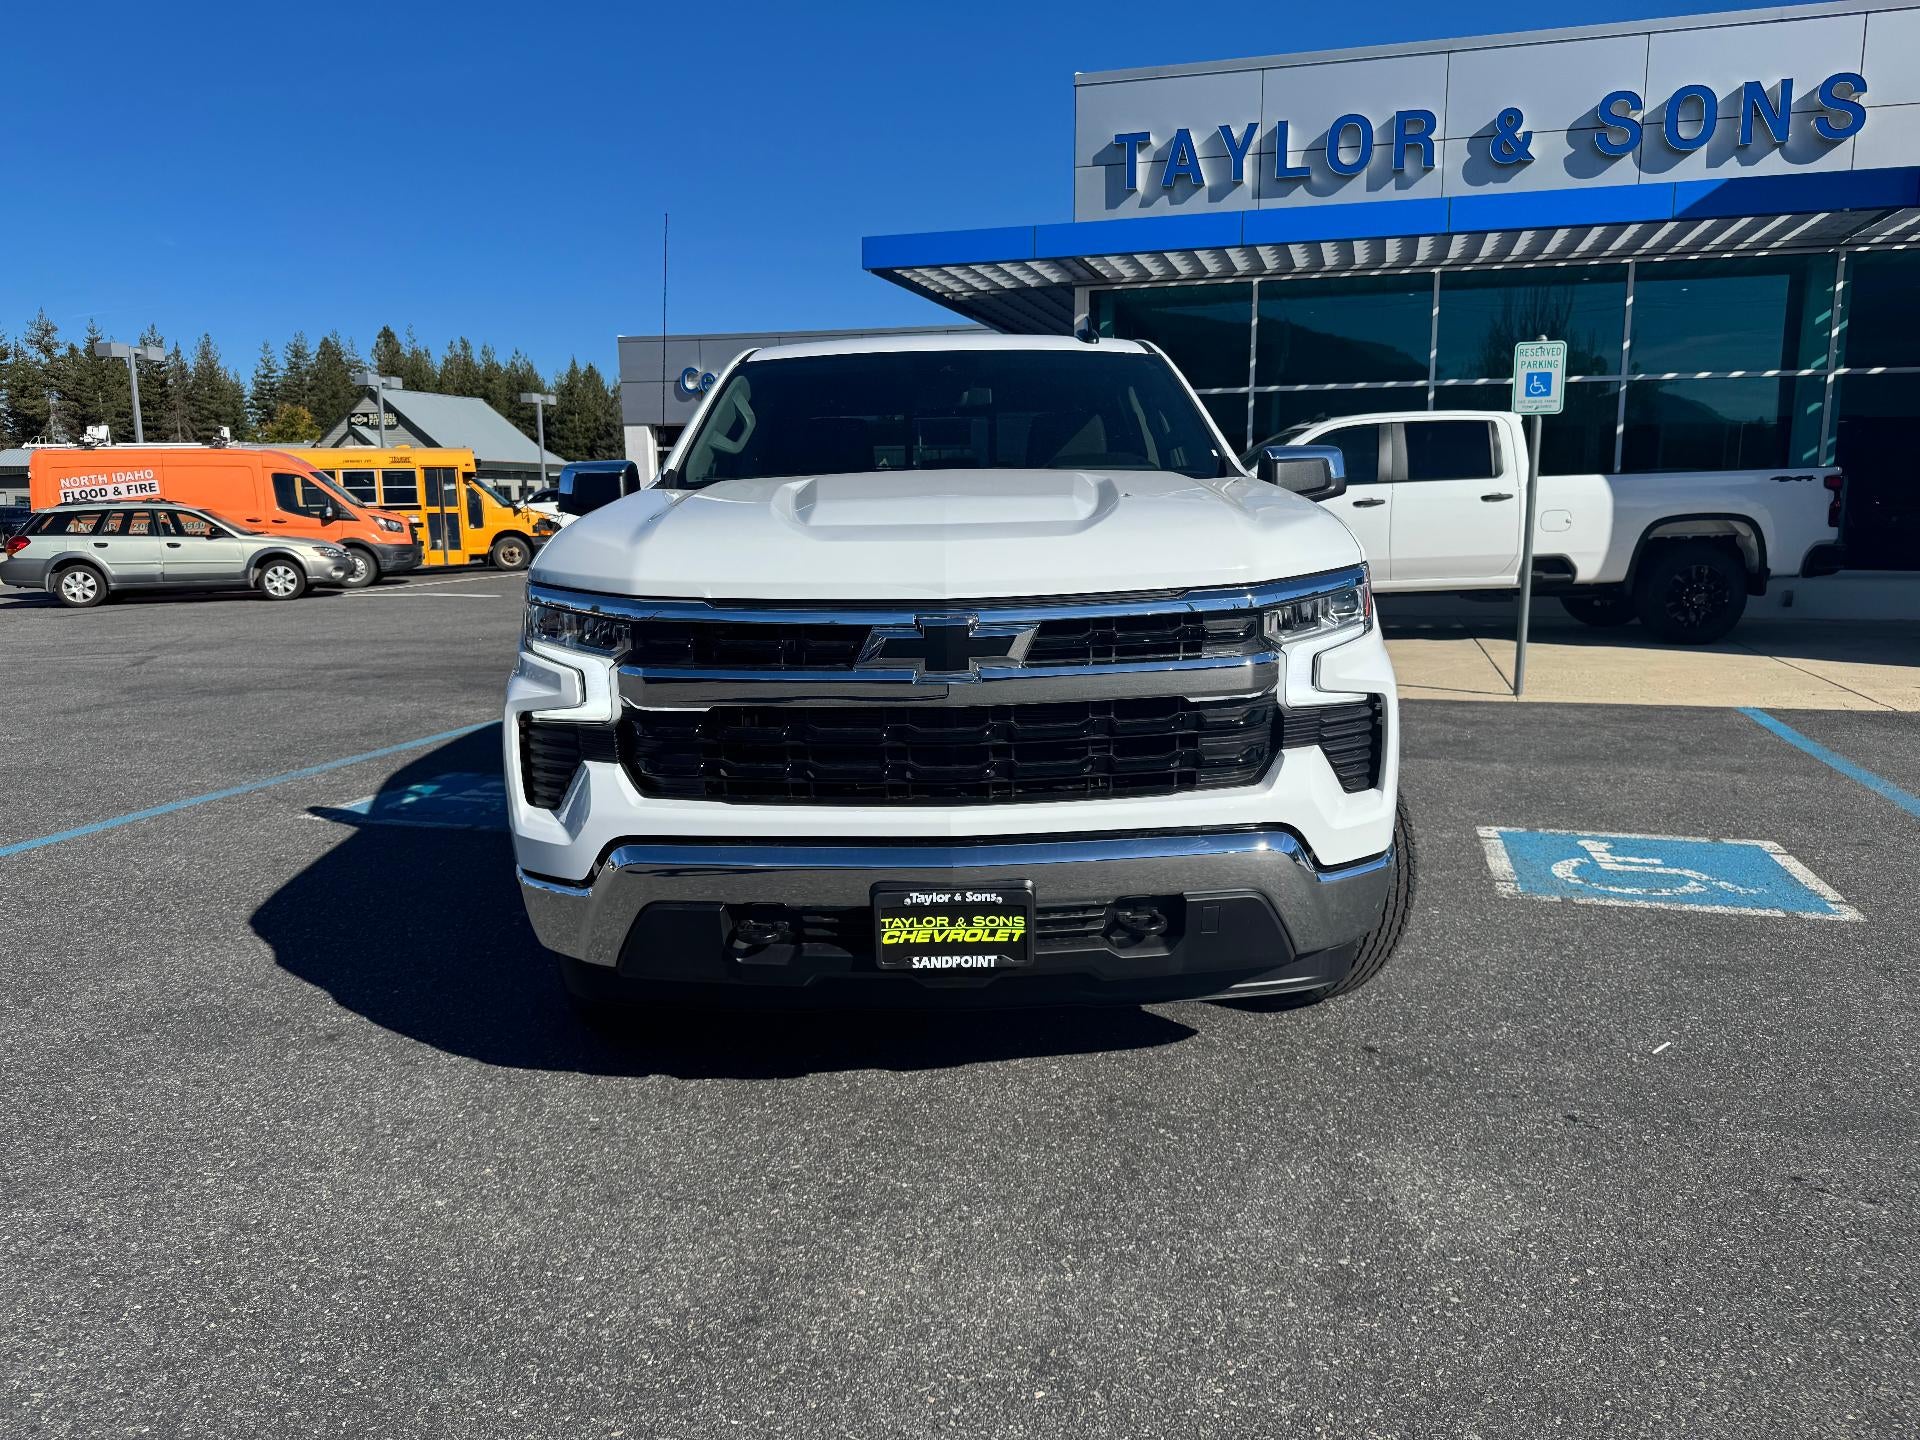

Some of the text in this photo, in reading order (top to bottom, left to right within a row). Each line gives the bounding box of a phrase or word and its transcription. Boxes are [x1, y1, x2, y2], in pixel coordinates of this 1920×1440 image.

[1113, 72, 1868, 191] TAYLOR & SONS
[1519, 347, 1562, 357] RESERVED
[1520, 359, 1559, 369] PARKING
[60, 469, 154, 489] NORTH IDAHO
[63, 482, 157, 501] FLOOD & FIRE
[909, 891, 997, 906] Taylor & Sons
[880, 915, 1026, 930] TAYLOR & SONS
[881, 929, 1027, 945] CHEVROLET
[912, 955, 998, 969] SANDPOINT
